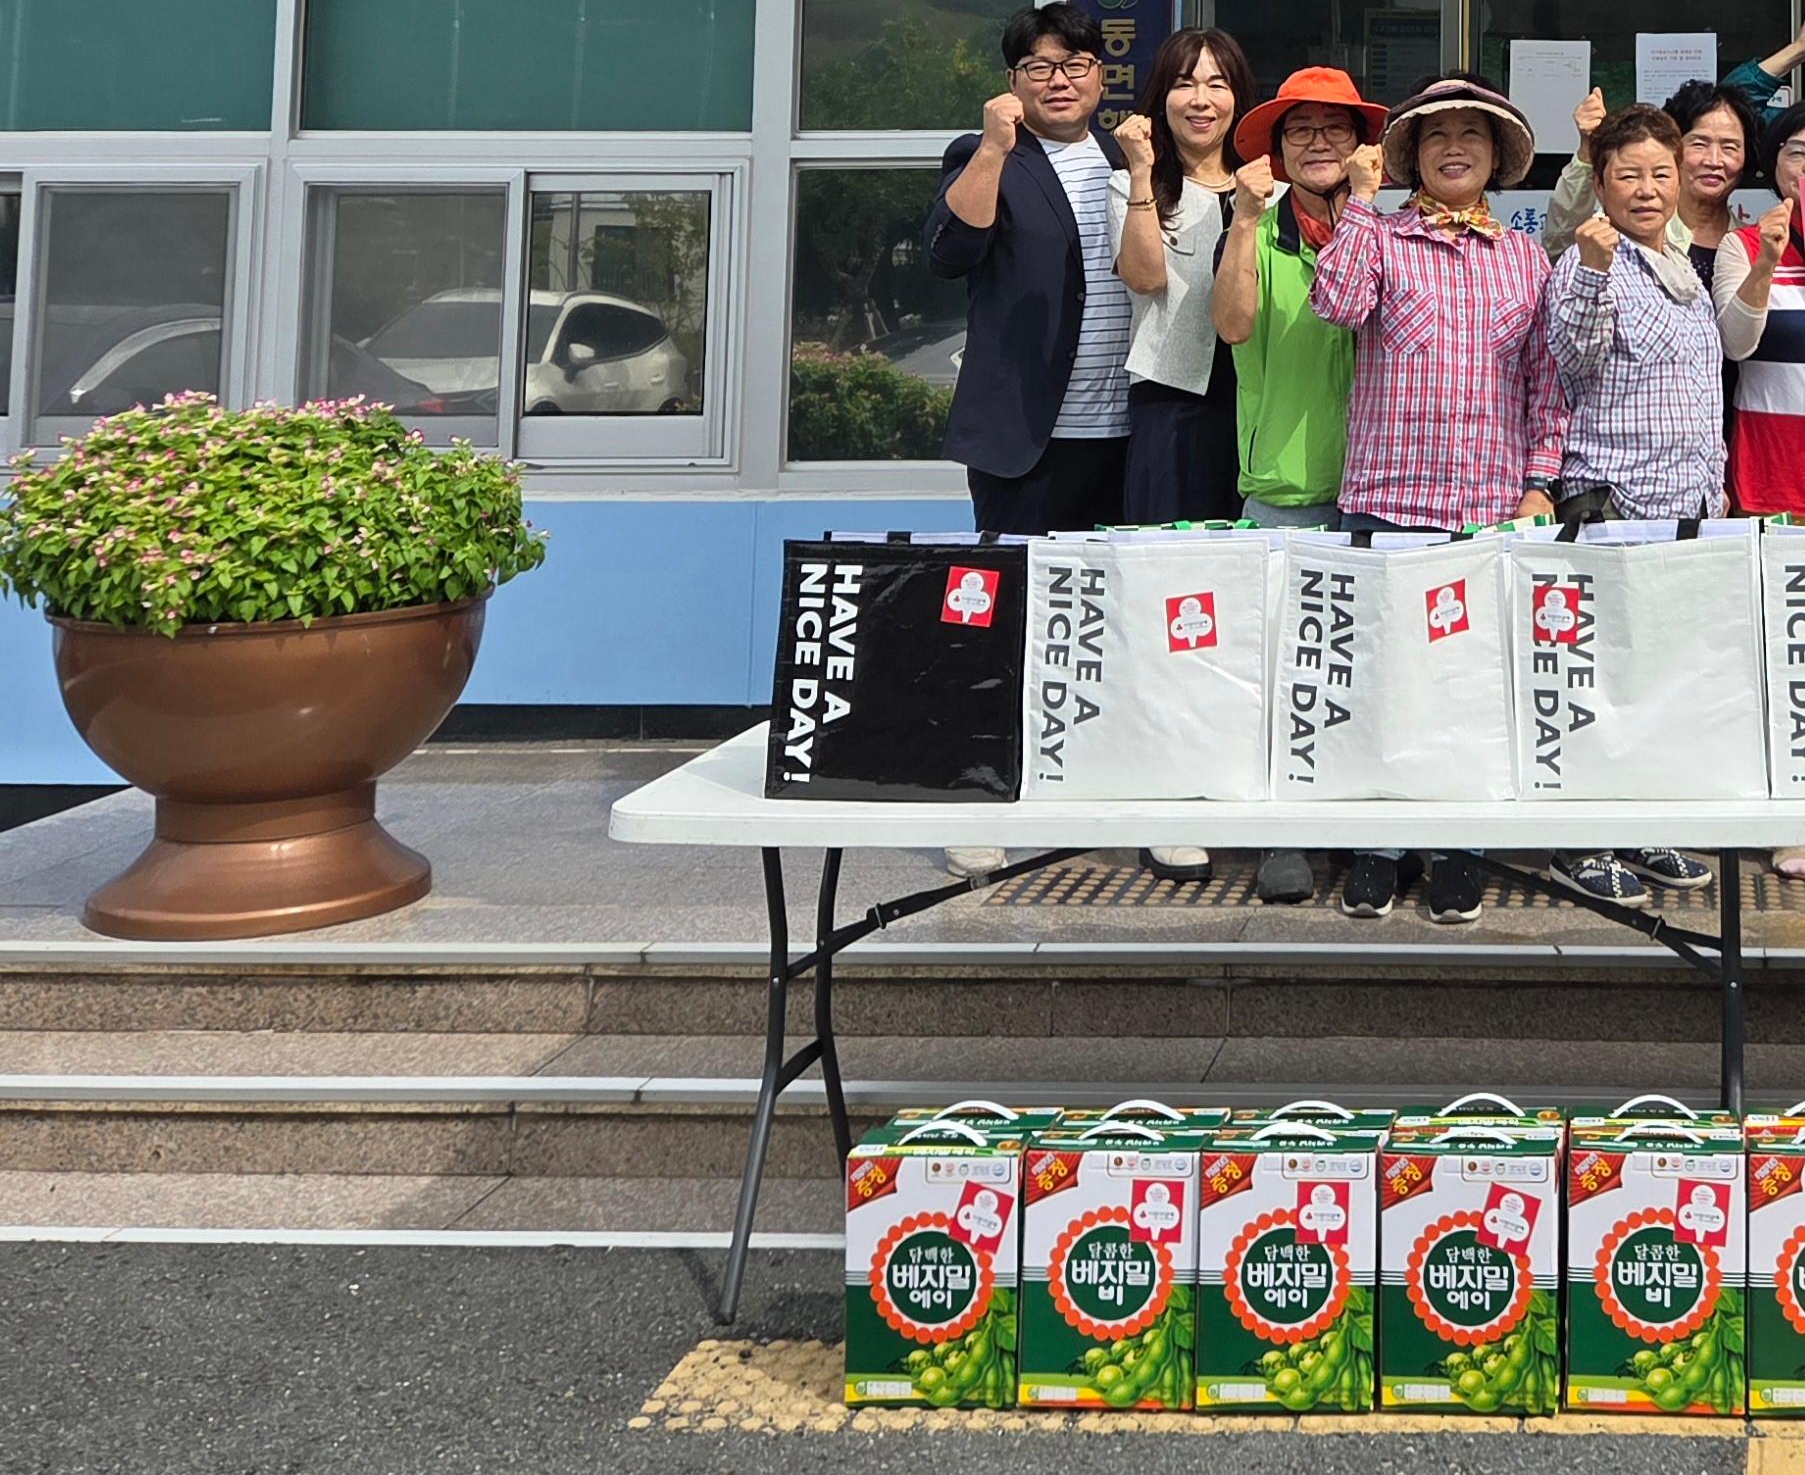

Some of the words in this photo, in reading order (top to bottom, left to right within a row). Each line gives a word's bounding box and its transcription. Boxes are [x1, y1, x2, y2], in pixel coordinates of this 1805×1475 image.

[795, 564, 828, 666] NICE
[827, 564, 864, 681] HAVE
[1045, 566, 1073, 668] NICE
[1075, 568, 1106, 683] HAVE
[1296, 570, 1324, 670] NICE
[1327, 573, 1355, 688] HAVE
[1567, 574, 1595, 689] HAVE
[823, 692, 851, 724] A
[1073, 694, 1100, 726] A
[1323, 699, 1351, 729] A
[1568, 701, 1596, 733] A
[783, 679, 819, 783] DAY!
[1040, 681, 1067, 782] DAY!
[1289, 683, 1318, 784] DAY!
[1533, 689, 1561, 789] DAY!
[856, 1164, 887, 1197] 증정
[1035, 1157, 1068, 1191] 증정
[1209, 1160, 1243, 1194] 증정
[1390, 1161, 1422, 1195] 증정
[1579, 1157, 1612, 1191] 증정
[1758, 1161, 1793, 1196] 증정
[909, 1247, 954, 1264] 담백한
[1088, 1242, 1132, 1258] 달콤한
[1265, 1245, 1310, 1262] 담백한
[1446, 1247, 1492, 1264] 담백한
[1634, 1244, 1680, 1261] 달콤한
[892, 1265, 971, 1290] 베지밀
[1072, 1260, 1150, 1285] 베지밀
[1247, 1263, 1326, 1288] 베지밀
[1428, 1265, 1508, 1291] 베지밀
[1617, 1261, 1697, 1288] 베지밀
[910, 1290, 951, 1309] 에이
[1099, 1286, 1122, 1306] 비
[1265, 1289, 1307, 1308] 에이
[1447, 1291, 1490, 1310] 에이
[1646, 1288, 1670, 1308] 비
